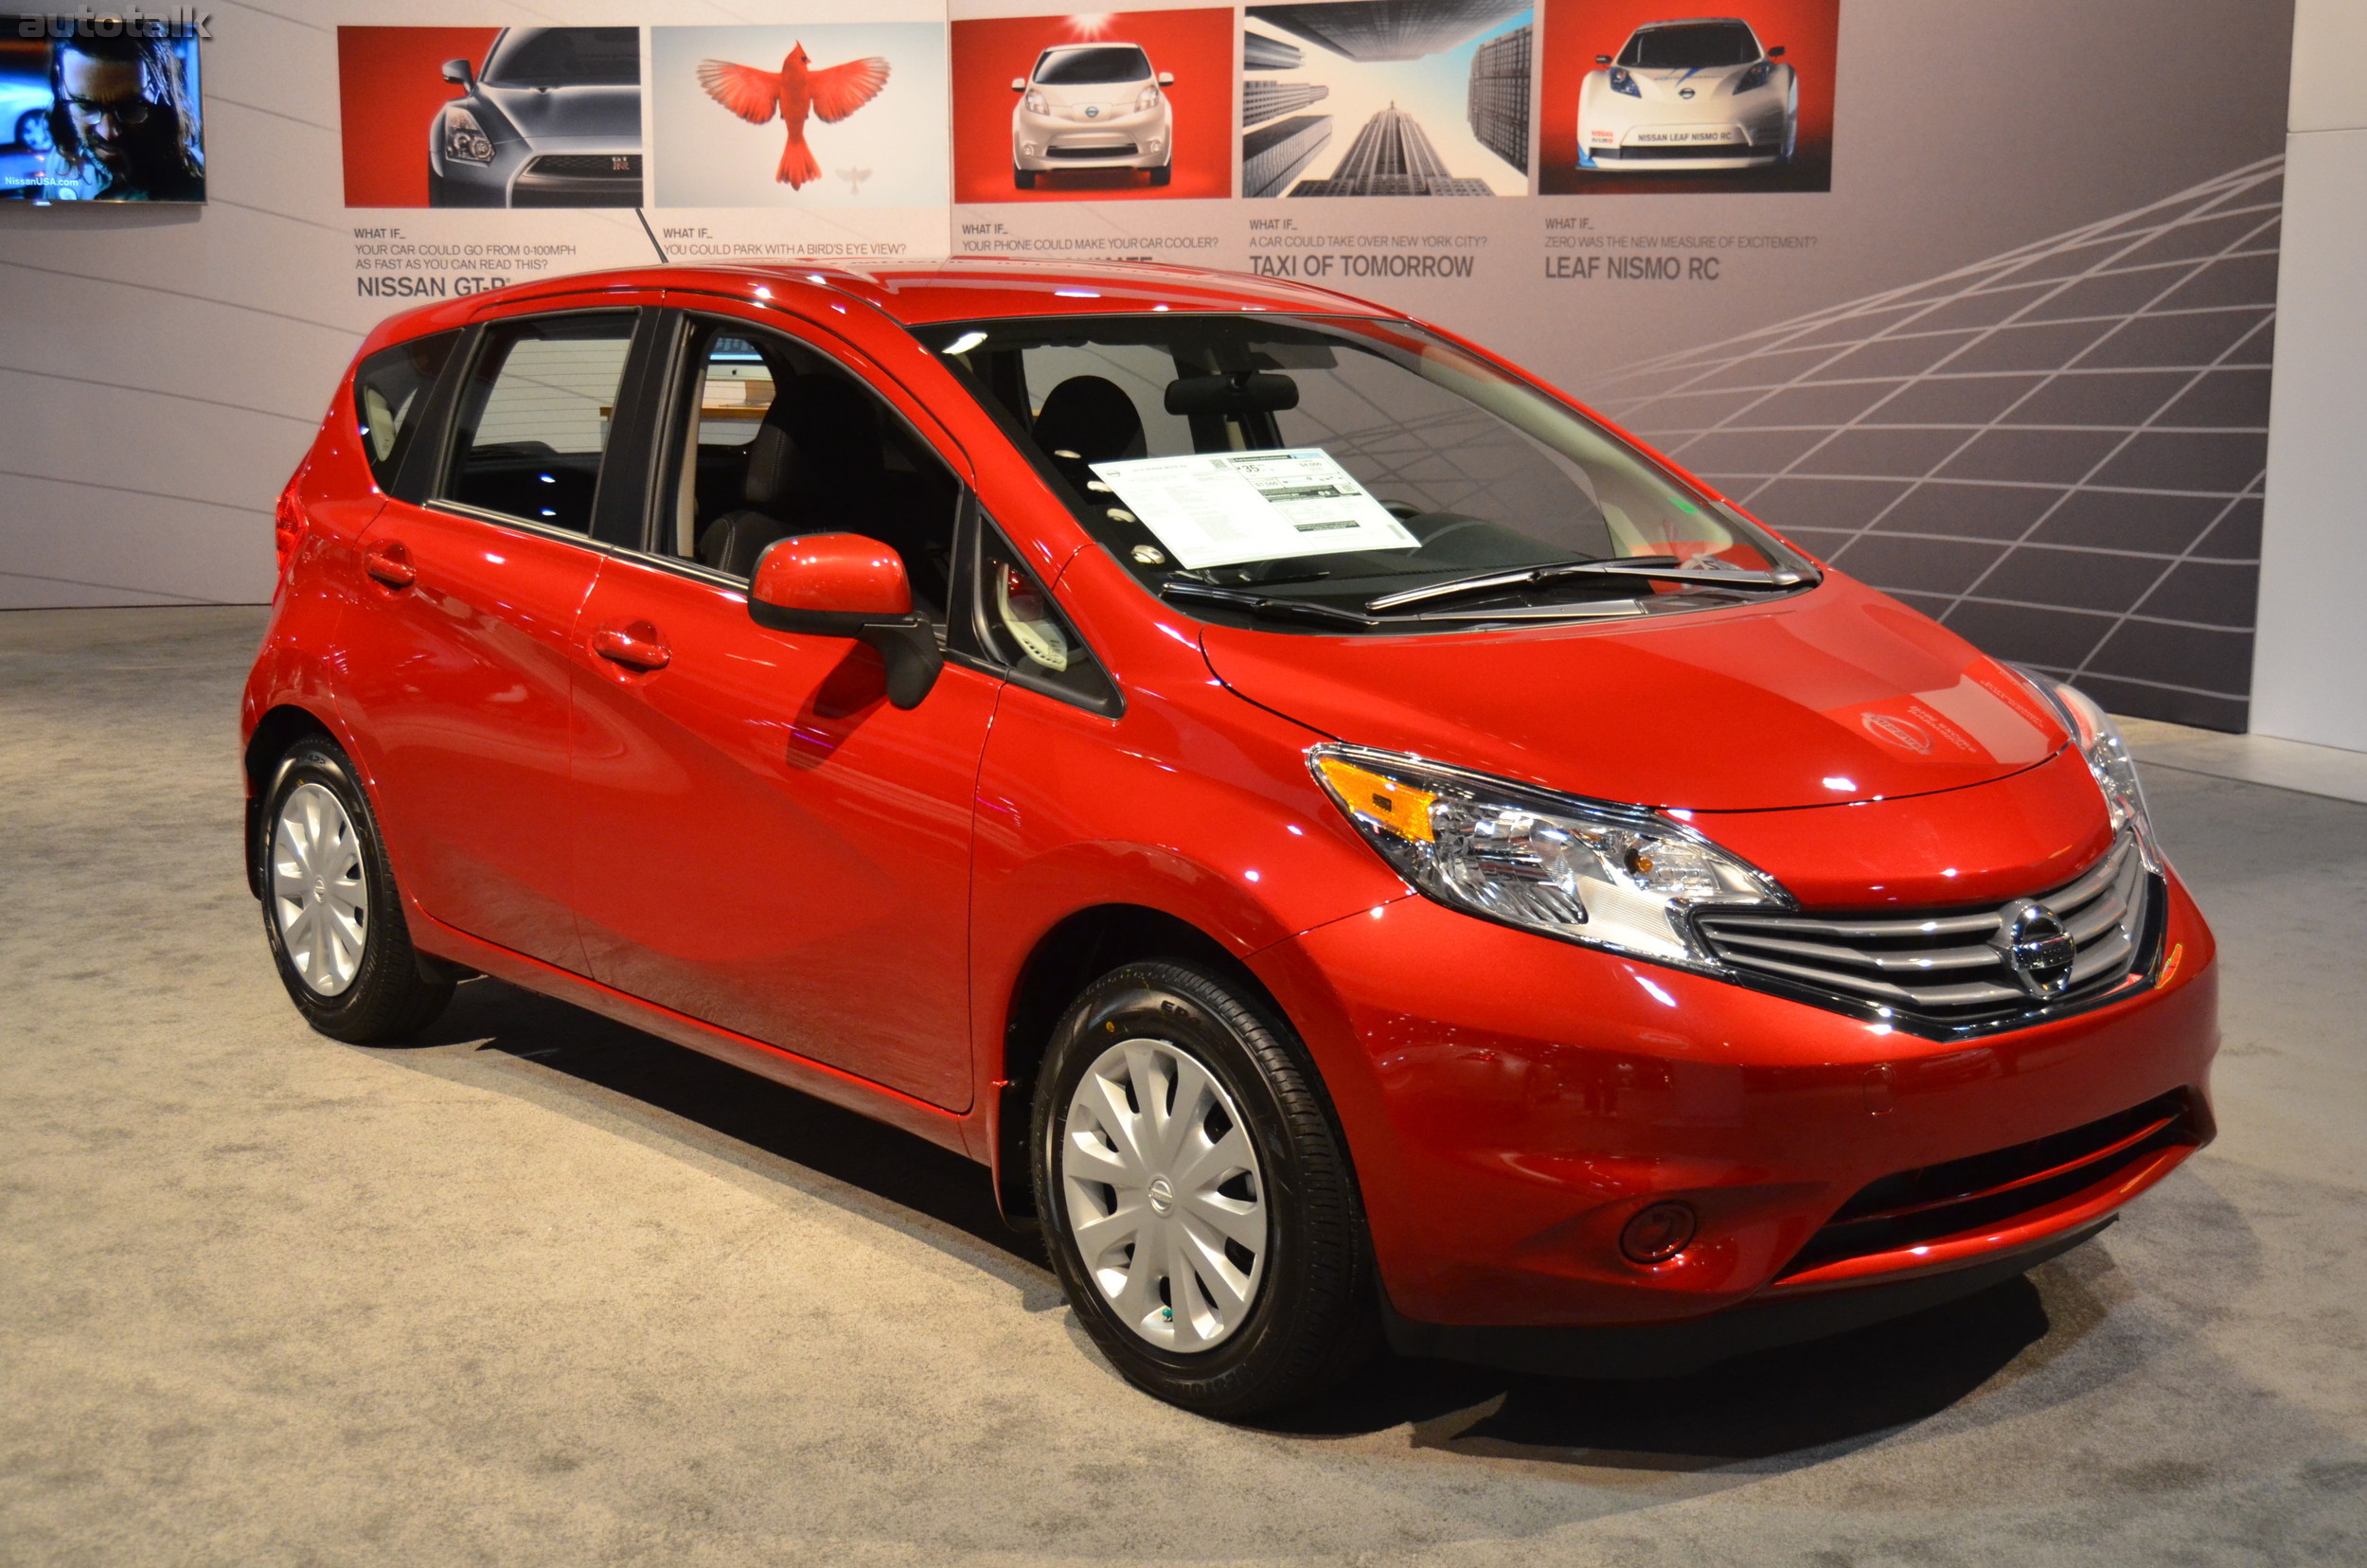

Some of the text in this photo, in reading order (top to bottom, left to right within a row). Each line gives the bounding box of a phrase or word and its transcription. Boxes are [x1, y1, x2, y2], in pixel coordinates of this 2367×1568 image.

[5, 176, 79, 187] NissanUSA.com
[962, 224, 1008, 234] WHAT IF_
[1250, 220, 1298, 230] WHAT IF_
[1545, 218, 1594, 230] WHAT IF_
[354, 229, 406, 239] WHAT IF_
[664, 228, 713, 239] WHAT IF_
[963, 237, 1219, 251] YOUR PHONE COULD MAKE YOUR CAR COOLER?
[1250, 237, 1487, 247] A CAR COULD TAKE OVER NEW YORK CITY?
[1545, 237, 1818, 249] ZERO WAS THE NEW MEASURE OF EXCITEMENT?
[355, 245, 576, 255] YOUR CAR COULD GO FROM 0-100MPH
[664, 243, 906, 256] YOU COULD PARK WITH A BIRD'S EYE VIEW?
[356, 259, 548, 270] AS FAST AS YOU CAN READ THIS?
[1250, 255, 1474, 277] TAXI OF TOMORROW
[1545, 257, 1719, 280] LEAF NISMO RC
[358, 276, 446, 296] NISSAN
